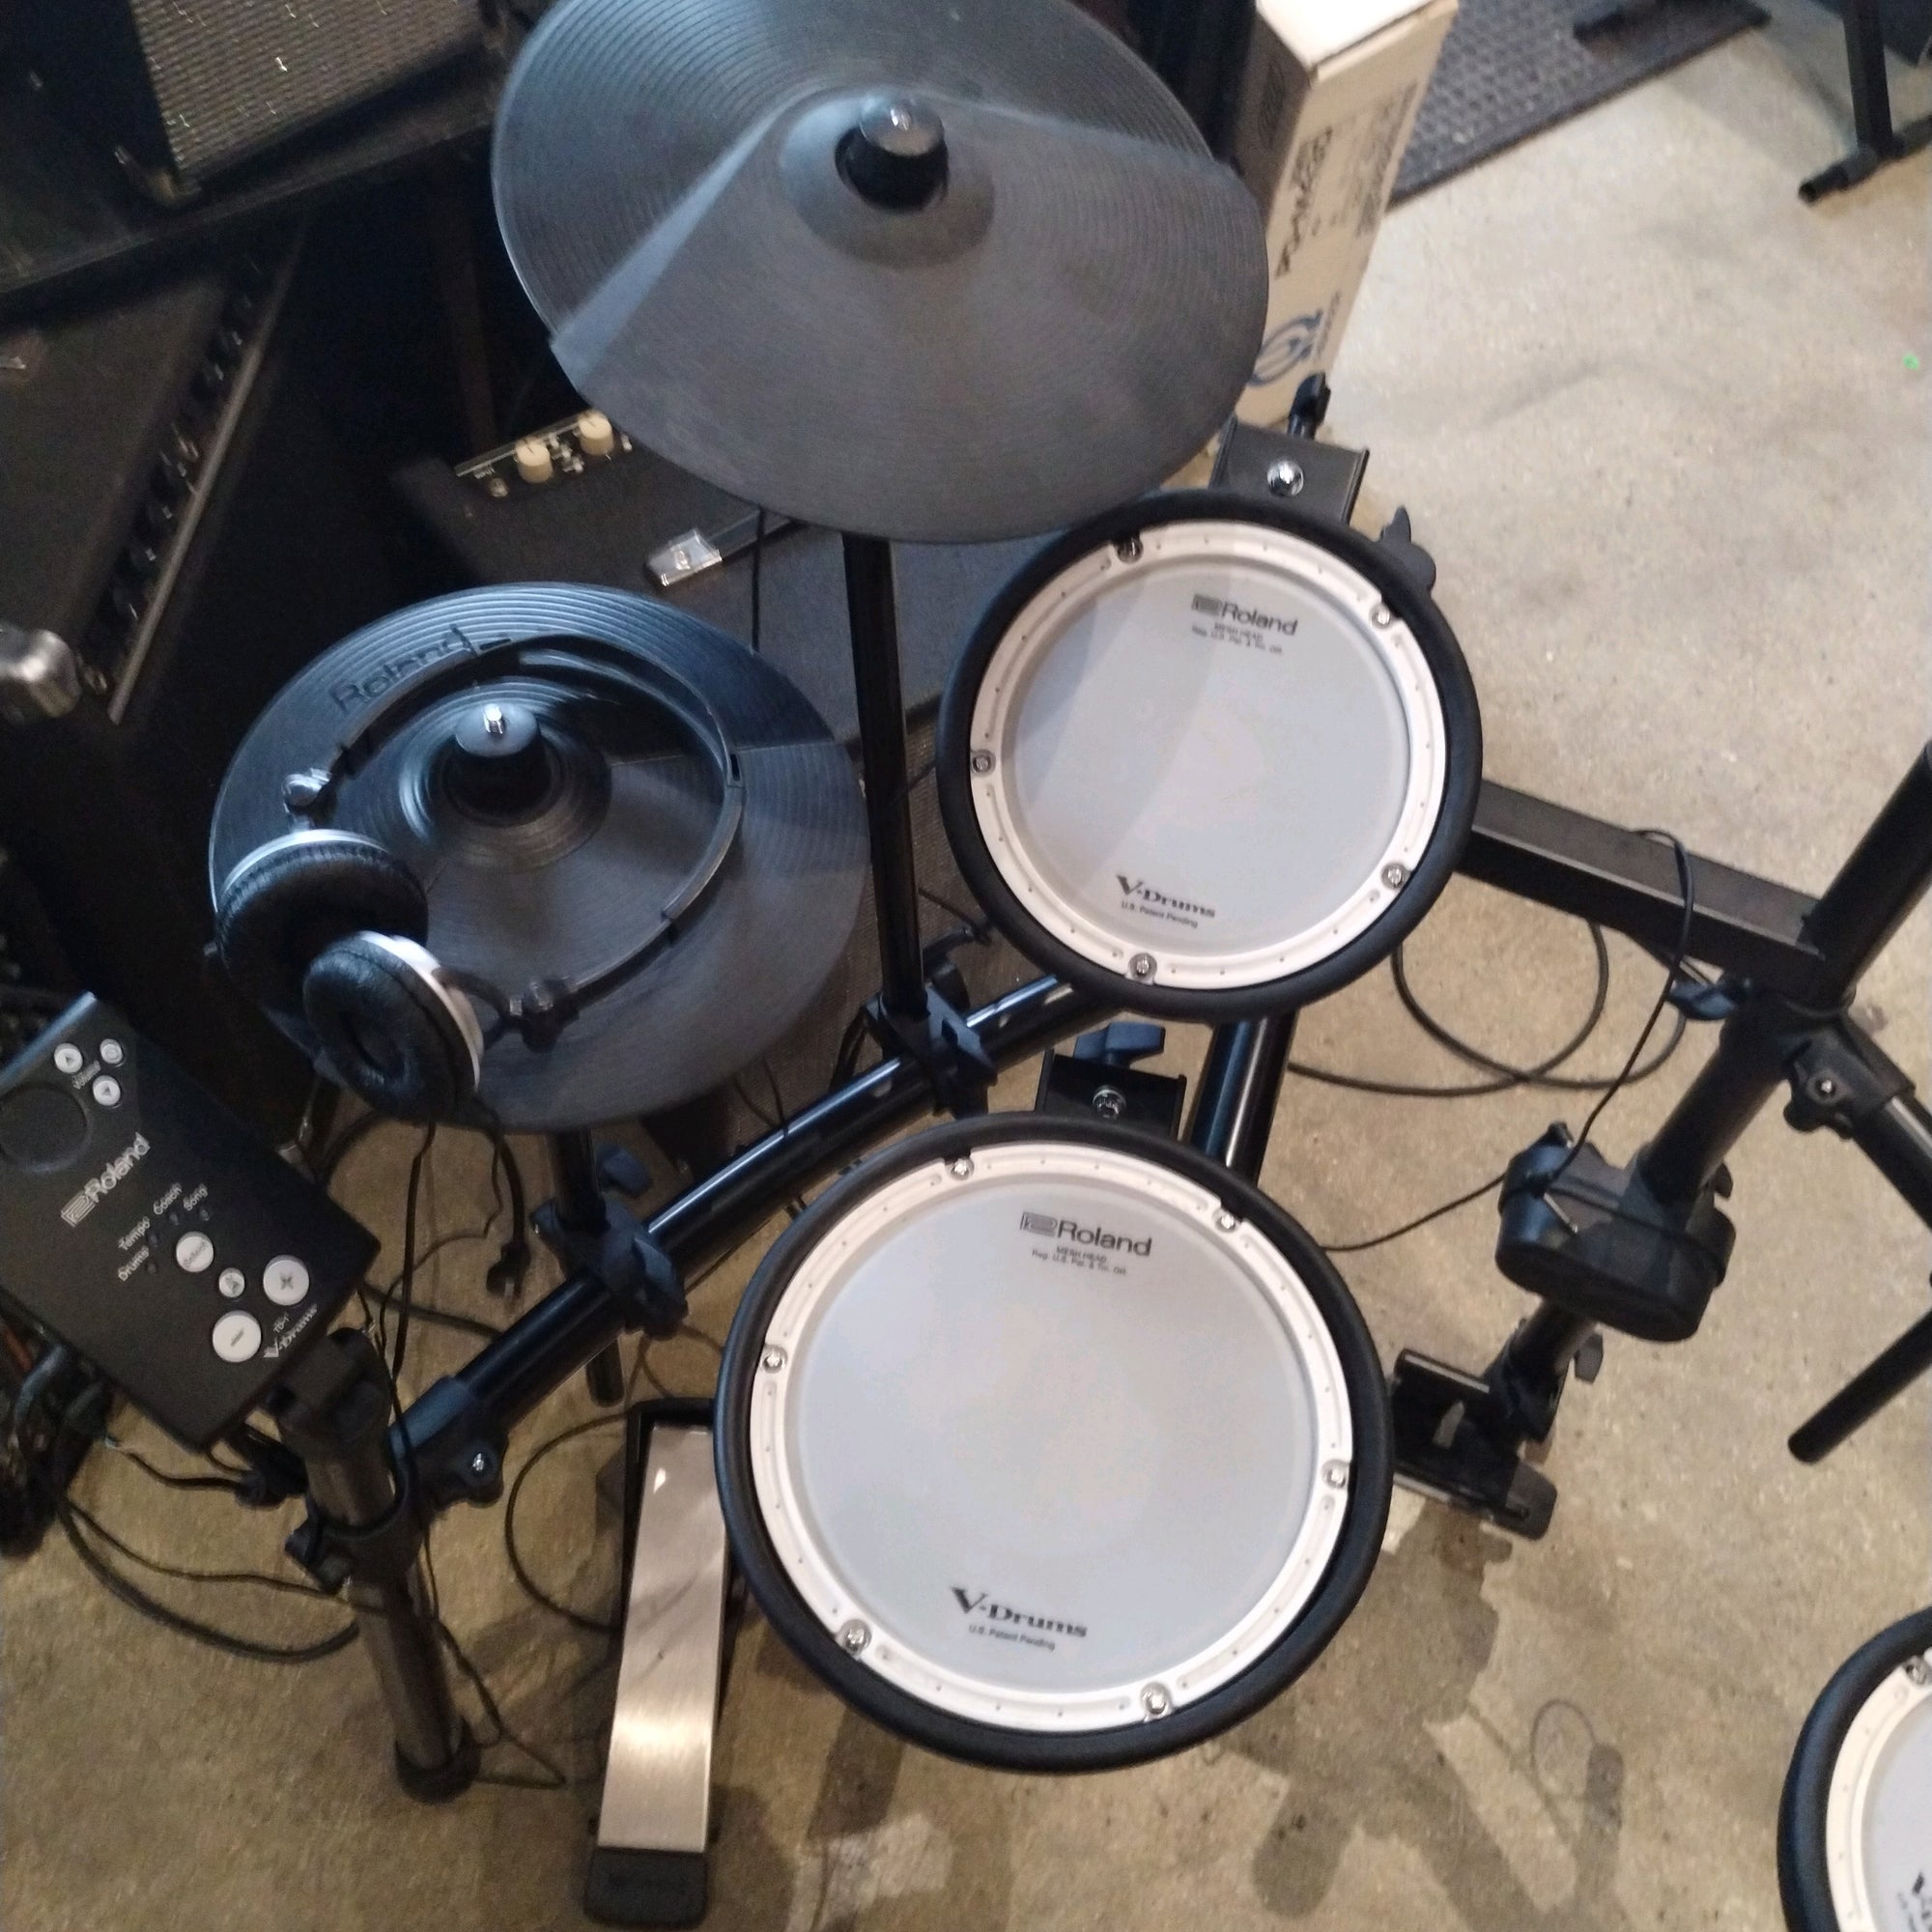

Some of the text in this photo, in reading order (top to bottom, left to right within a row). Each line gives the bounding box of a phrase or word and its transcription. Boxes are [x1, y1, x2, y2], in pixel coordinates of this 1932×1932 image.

[1222, 601, 1298, 637] Roland
[1117, 875, 1215, 919] V-Drums
[84, 1131, 151, 1203] Roland
[118, 1215, 150, 1251] Tempo
[1057, 1219, 1152, 1257] Roland
[118, 1245, 150, 1282] Drums
[951, 1586, 1088, 1638] V-Drums
